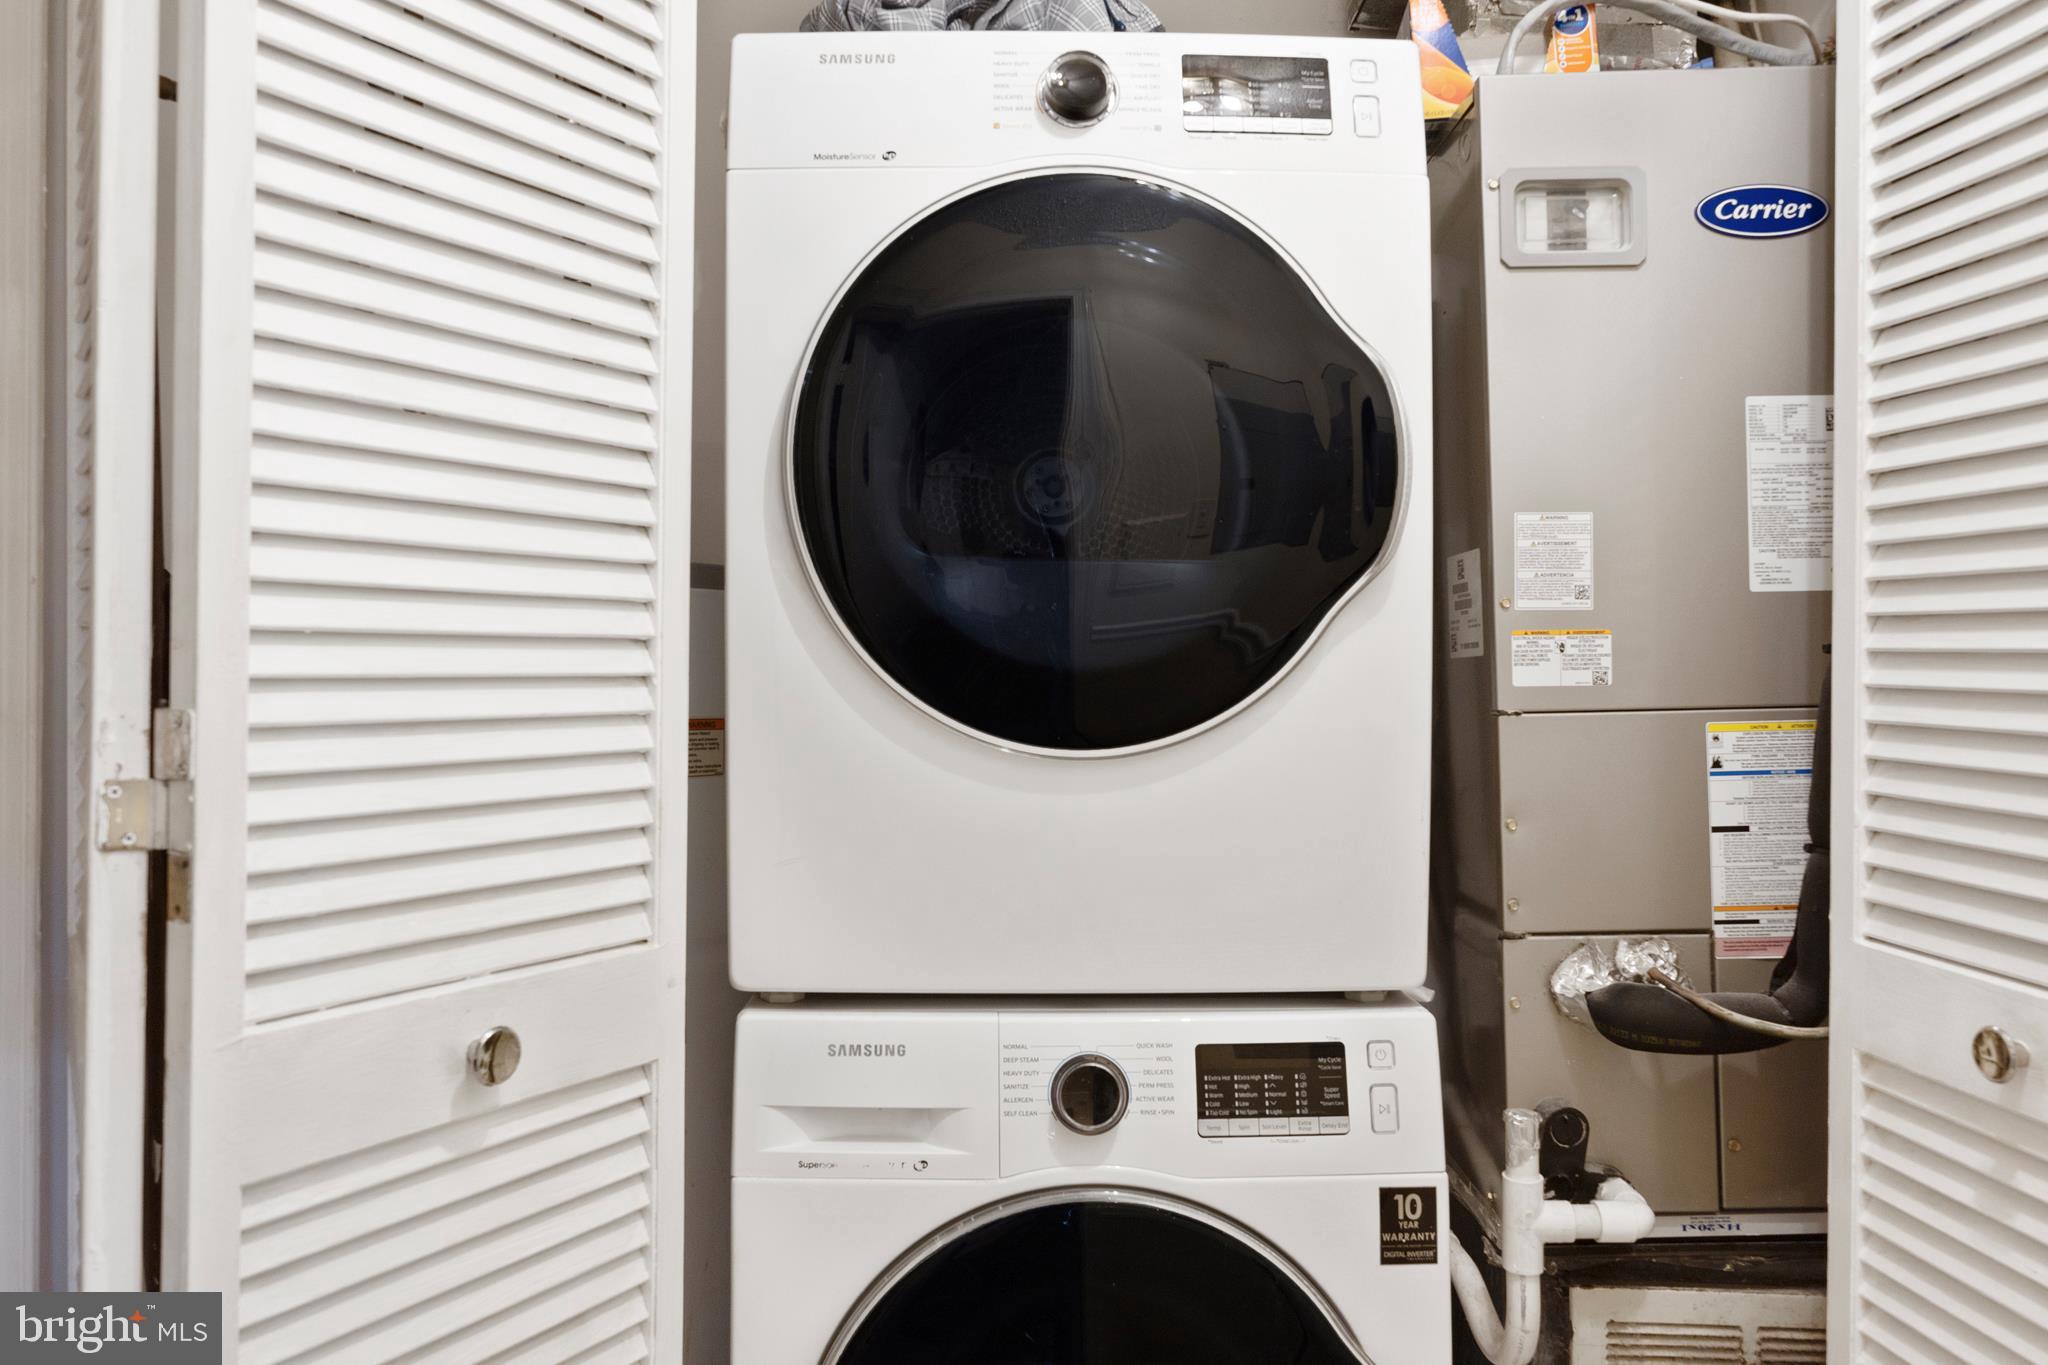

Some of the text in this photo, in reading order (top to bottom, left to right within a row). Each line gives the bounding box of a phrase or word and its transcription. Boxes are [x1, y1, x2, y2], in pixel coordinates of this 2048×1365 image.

[819, 53, 897, 65] SAMSUNG
[1714, 197, 1813, 221] Carrier
[827, 1043, 907, 1057] SAMSUNG
[1136, 1042, 1154, 1050] QUICK
[1143, 1068, 1174, 1076] DELICATES
[1003, 1096, 1034, 1104] ALLERGEN
[1393, 1192, 1423, 1221] 10
[1398, 1220, 1420, 1230] YEAR
[1382, 1231, 1436, 1242] WARRANTY
[1383, 1250, 1435, 1258] DIGITAL INVERTER
